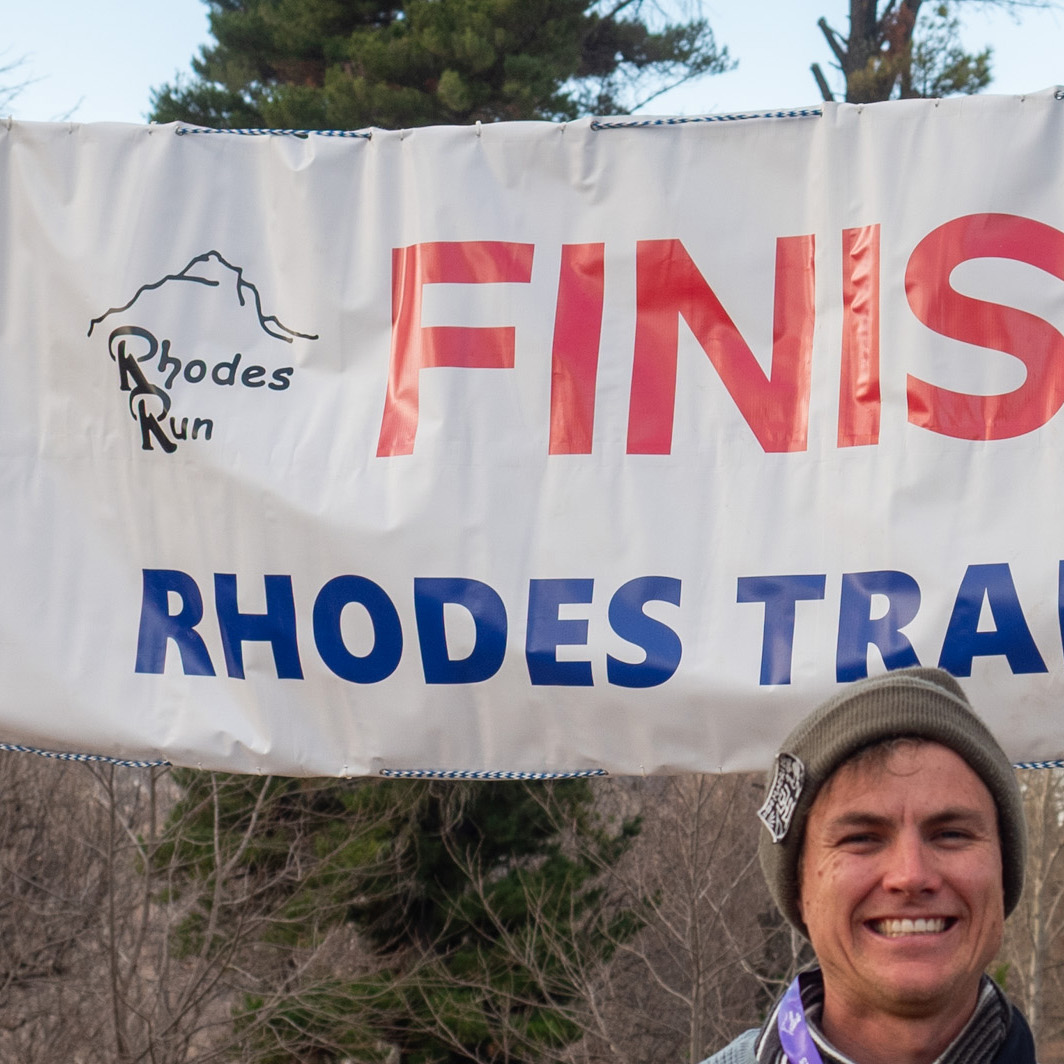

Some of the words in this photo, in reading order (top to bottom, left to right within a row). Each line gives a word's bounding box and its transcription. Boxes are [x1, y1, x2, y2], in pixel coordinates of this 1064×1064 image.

[108, 326, 294, 392] Rhodes
[129, 385, 214, 453] Run
[135, 568, 683, 688] RHODES
